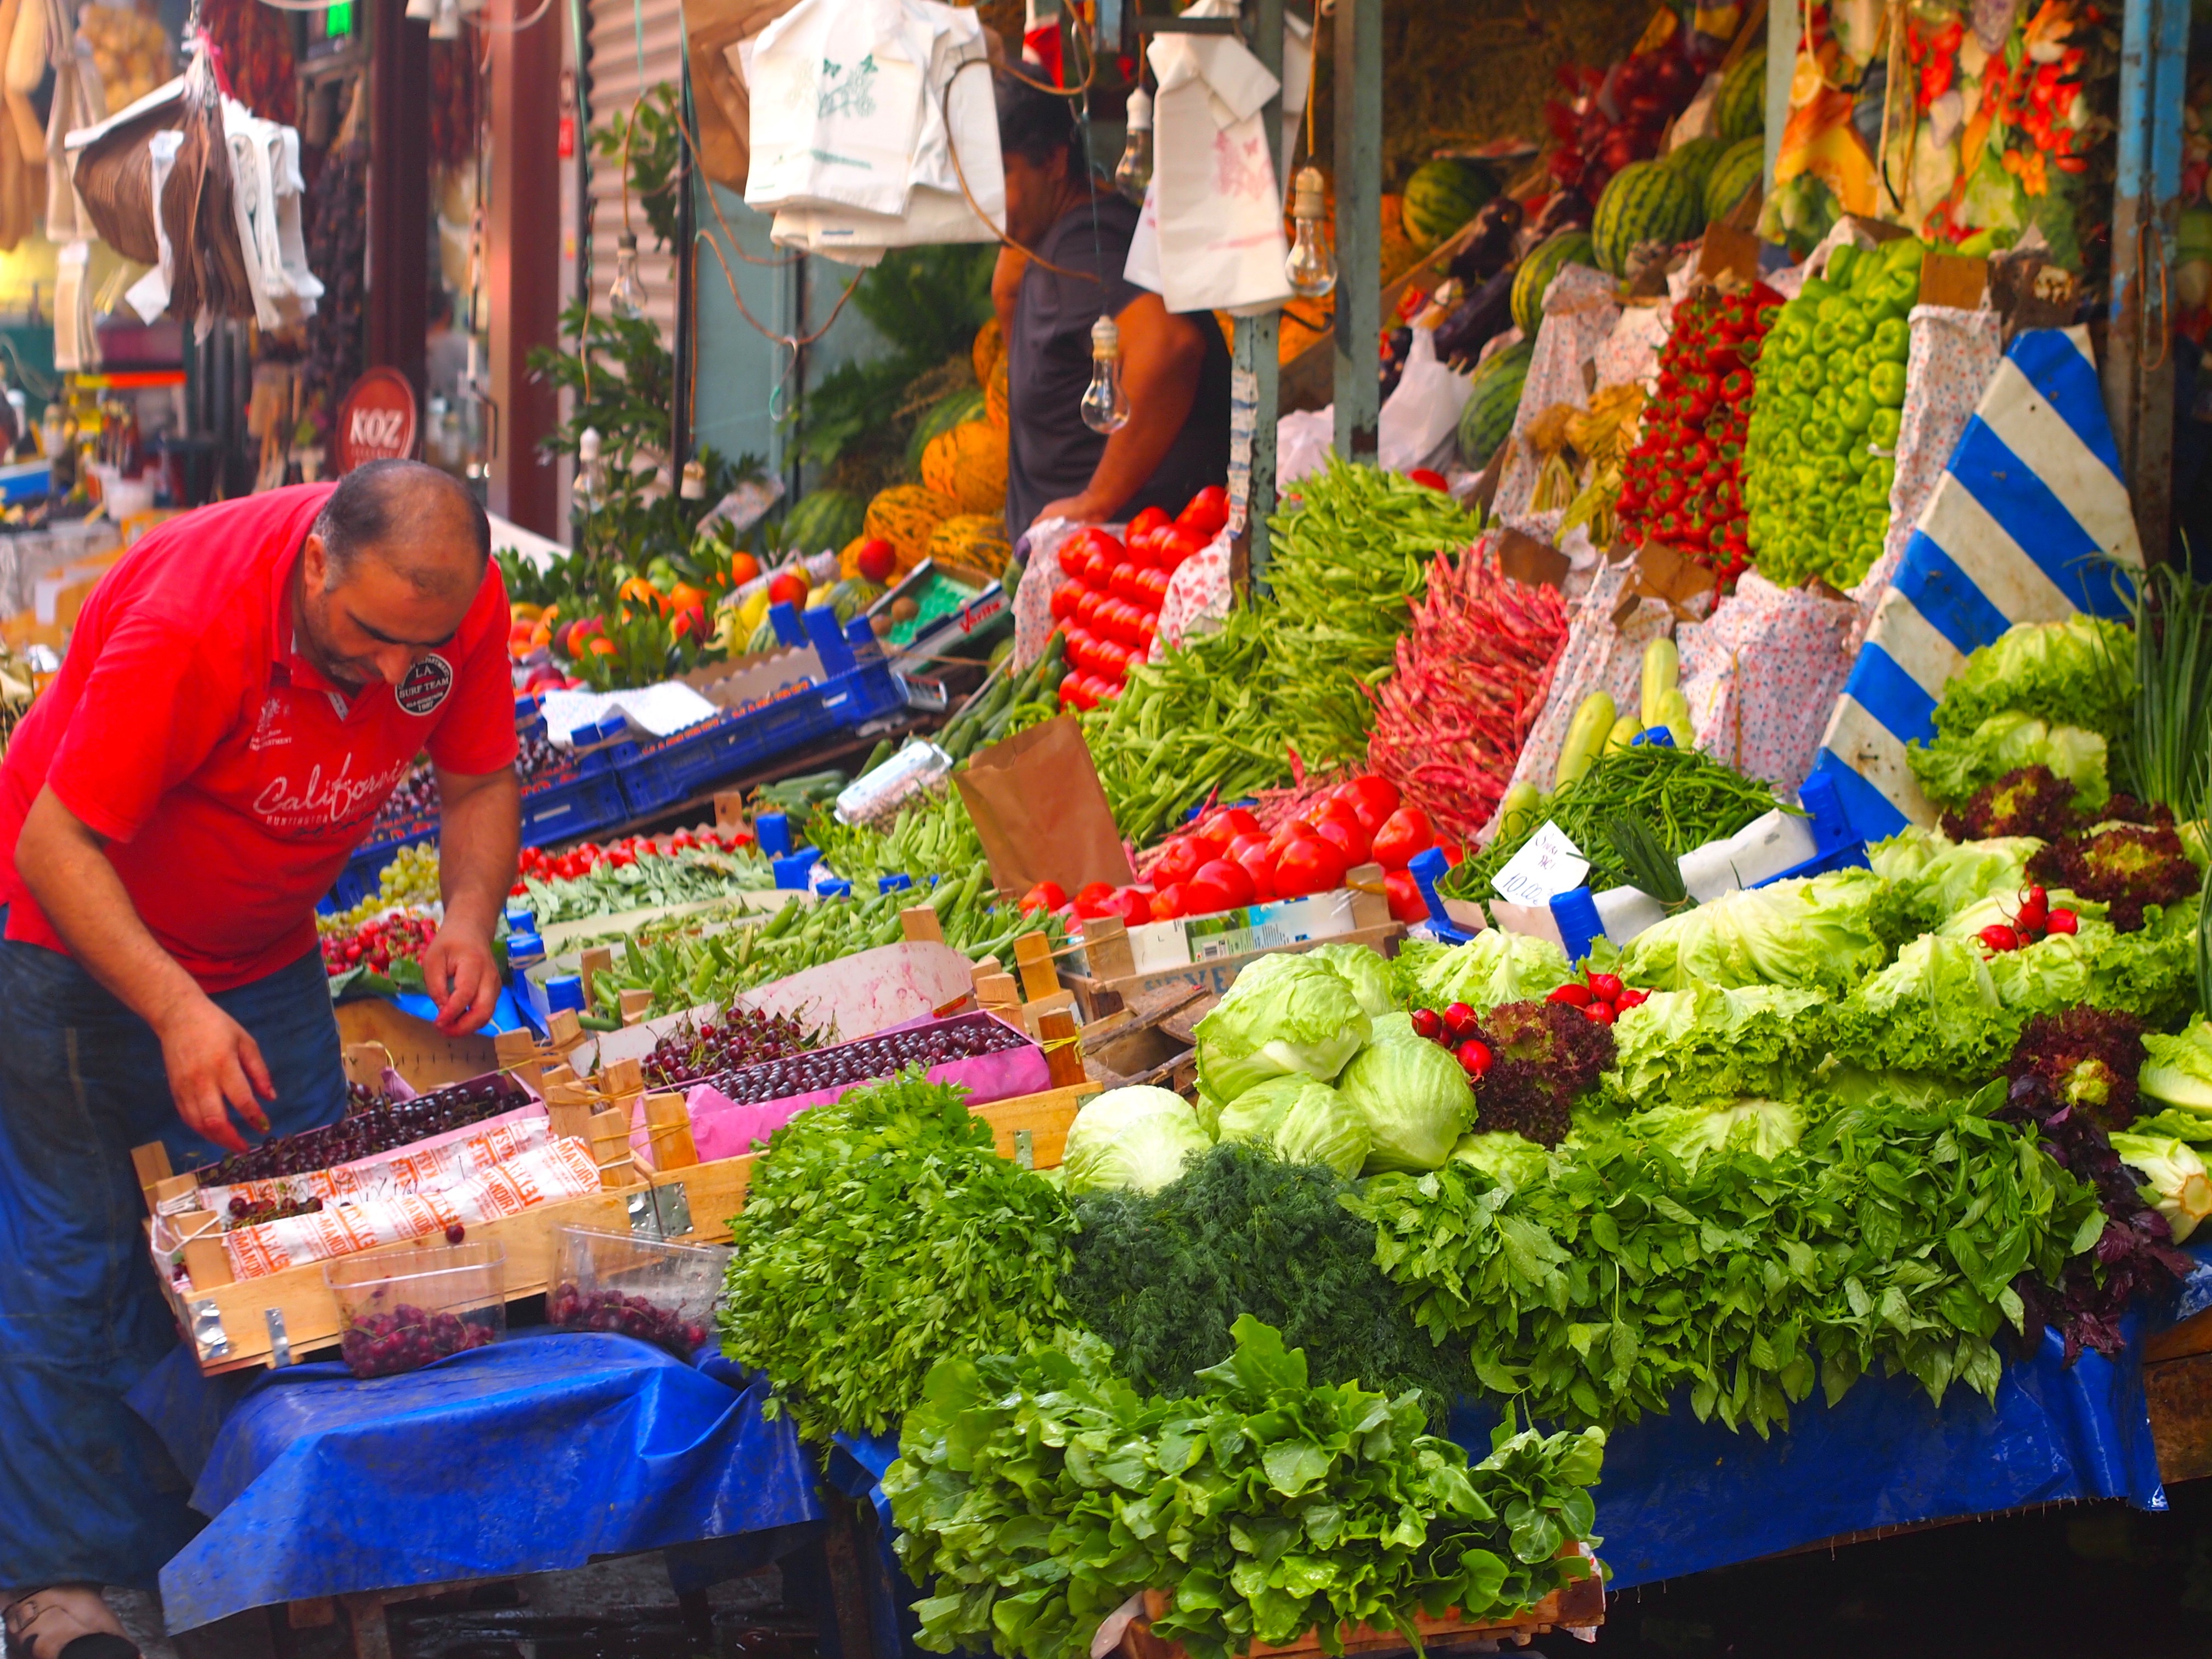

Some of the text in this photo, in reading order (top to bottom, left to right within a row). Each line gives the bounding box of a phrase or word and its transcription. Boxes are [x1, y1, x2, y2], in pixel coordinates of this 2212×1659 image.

[350, 408, 403, 448] KOZ
[399, 677, 449, 698] SURF TEAM
[492, 1126, 517, 1162] KASA
[503, 1159, 544, 1207] ARKET
